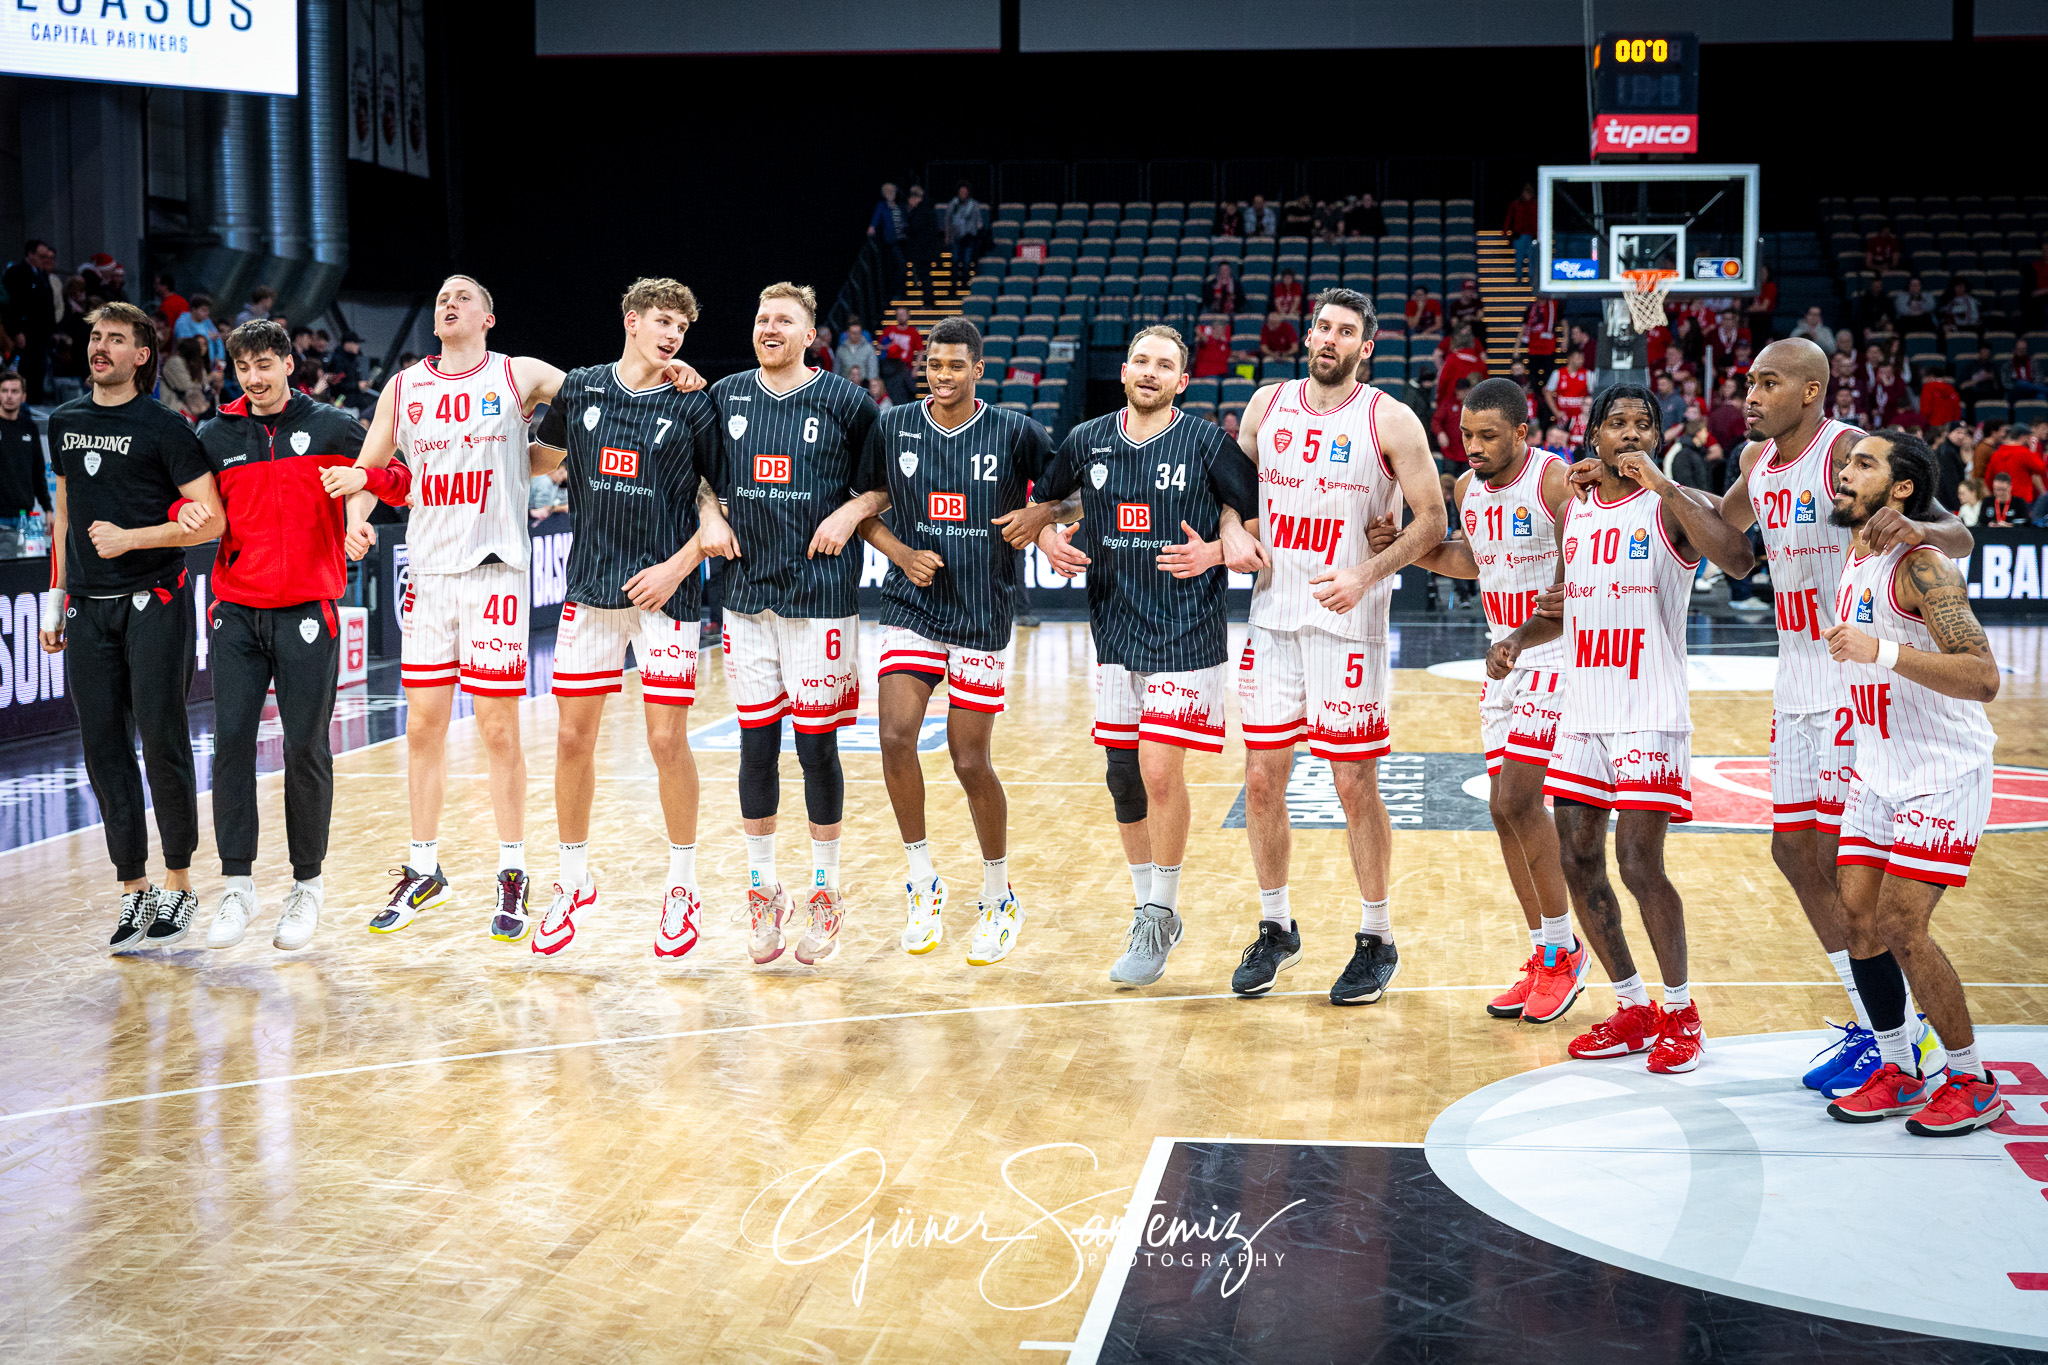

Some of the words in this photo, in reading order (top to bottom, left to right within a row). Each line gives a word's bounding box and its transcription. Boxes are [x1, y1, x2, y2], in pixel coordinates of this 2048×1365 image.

[31, 22, 98, 46] CAPITAL
[107, 29, 189, 53] PARTNERS
[1604, 119, 1691, 148] tipico
[435, 392, 470, 423] 40
[654, 417, 673, 444] 7
[803, 416, 819, 443] 6
[62, 432, 132, 455] SPALDING
[1302, 428, 1323, 463] 5
[223, 453, 247, 466] SPALDING
[604, 452, 634, 473] DB
[758, 459, 787, 478] DB
[970, 453, 998, 481] 12
[422, 463, 494, 514] KNAUF
[589, 477, 611, 491] egio
[614, 481, 653, 498] Bayern
[1155, 463, 1187, 491] 34
[1327, 482, 1370, 494] SPRINTIS
[736, 486, 766, 500] Regio
[769, 488, 811, 501] Bayern
[934, 497, 962, 516] DB
[1123, 508, 1148, 527] DB
[1763, 489, 1791, 529] 20
[1796, 513, 1814, 522] BBL
[946, 525, 988, 538] Bayern
[1485, 505, 1503, 541] 11
[1514, 527, 1530, 535] BBL
[1102, 535, 1129, 549] Regio
[1132, 537, 1172, 550] Bayern
[1590, 527, 1621, 564] 10
[1630, 549, 1647, 558] BBL
[1792, 545, 1840, 557] PRINTIS
[483, 594, 518, 626] 40
[1857, 612, 1872, 621] BBL
[826, 628, 841, 660] 6
[1573, 616, 1645, 680] NAUF
[1345, 653, 1364, 689] 5
[1834, 707, 1855, 747] 2
